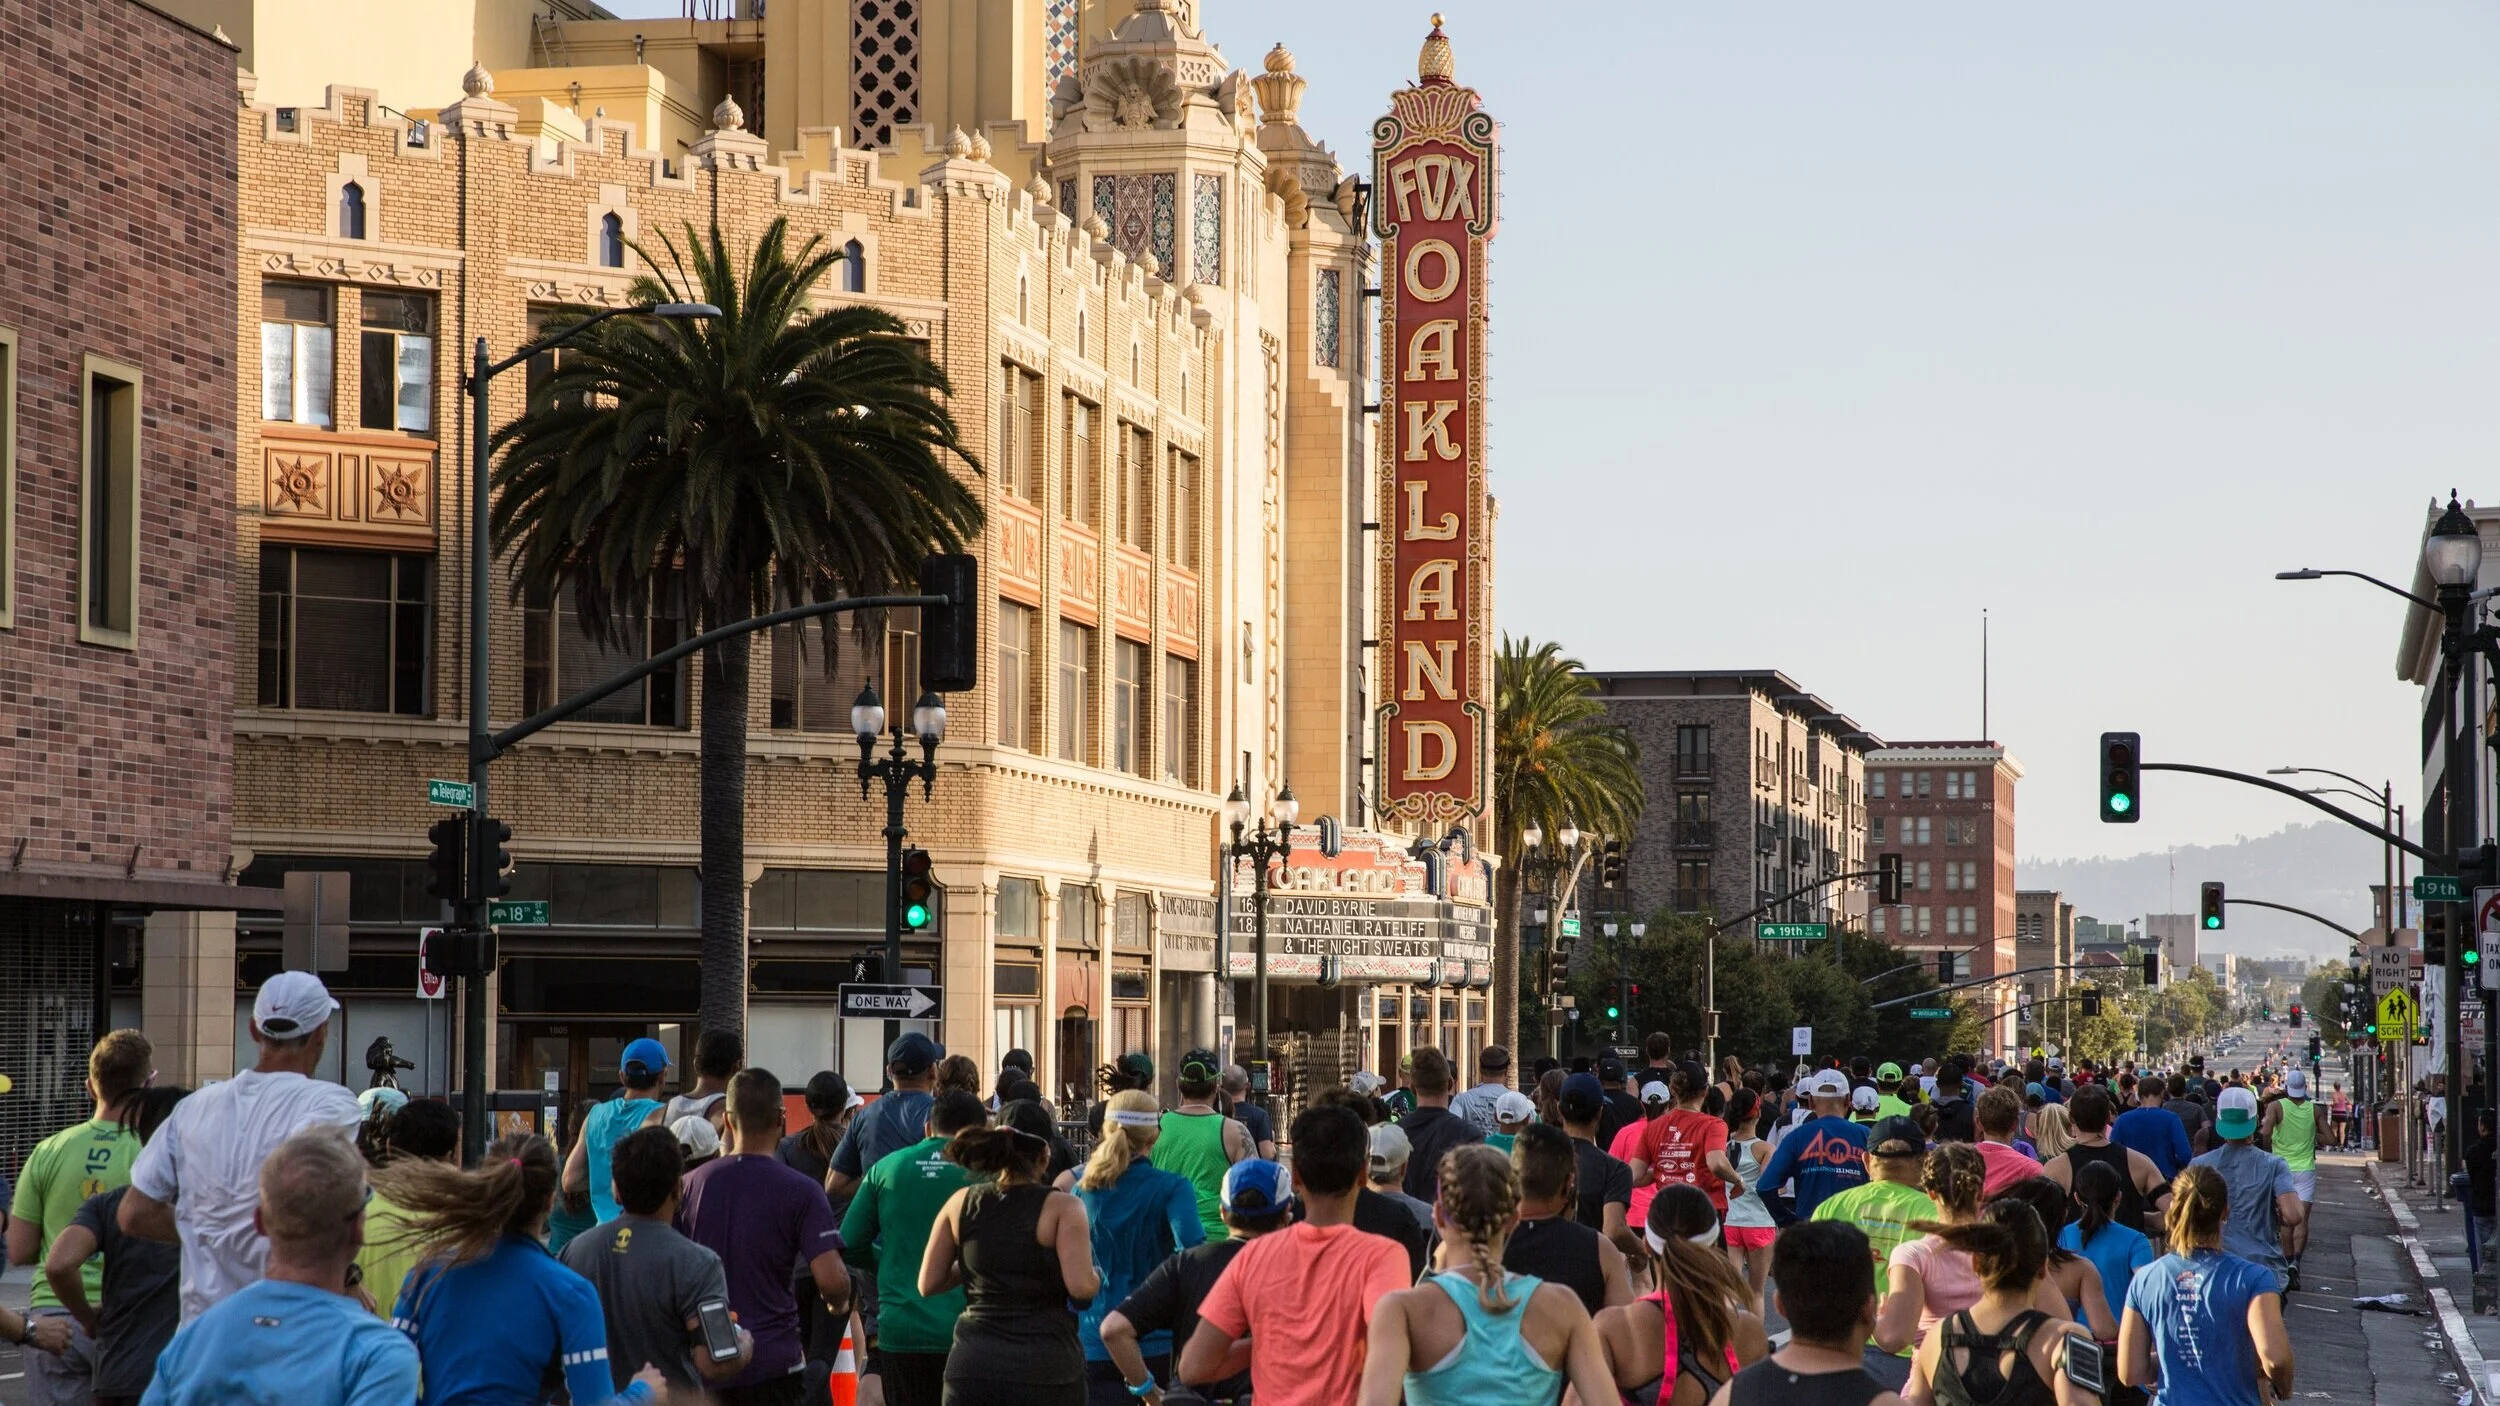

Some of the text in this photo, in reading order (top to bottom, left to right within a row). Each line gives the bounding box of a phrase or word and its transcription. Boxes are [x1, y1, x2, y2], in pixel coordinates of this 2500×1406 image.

[1391, 154, 1476, 222] FOX
[1403, 238, 1461, 781] OAKLAND
[439, 784, 466, 804] Telegraph
[1271, 865, 1396, 893] OAKLAND
[2420, 882, 2456, 896] 19th
[1285, 899, 1327, 915] DAVID
[1332, 901, 1376, 916] BYRNE
[1285, 919, 1359, 935] NATHANIEL
[1364, 921, 1425, 937] RATELIFF
[1779, 926, 1803, 936] 19th
[1285, 937, 1294, 953] &
[1300, 938, 1324, 954] THE
[1330, 939, 1368, 955] NIGHT
[1374, 940, 1429, 956] SWEATS
[2382, 953, 2400, 964] NO
[2375, 968, 2405, 977] RIGHT
[2377, 980, 2404, 990] TURN
[855, 995, 911, 1008] ONE WAY
[86, 1148, 111, 1175] 15
